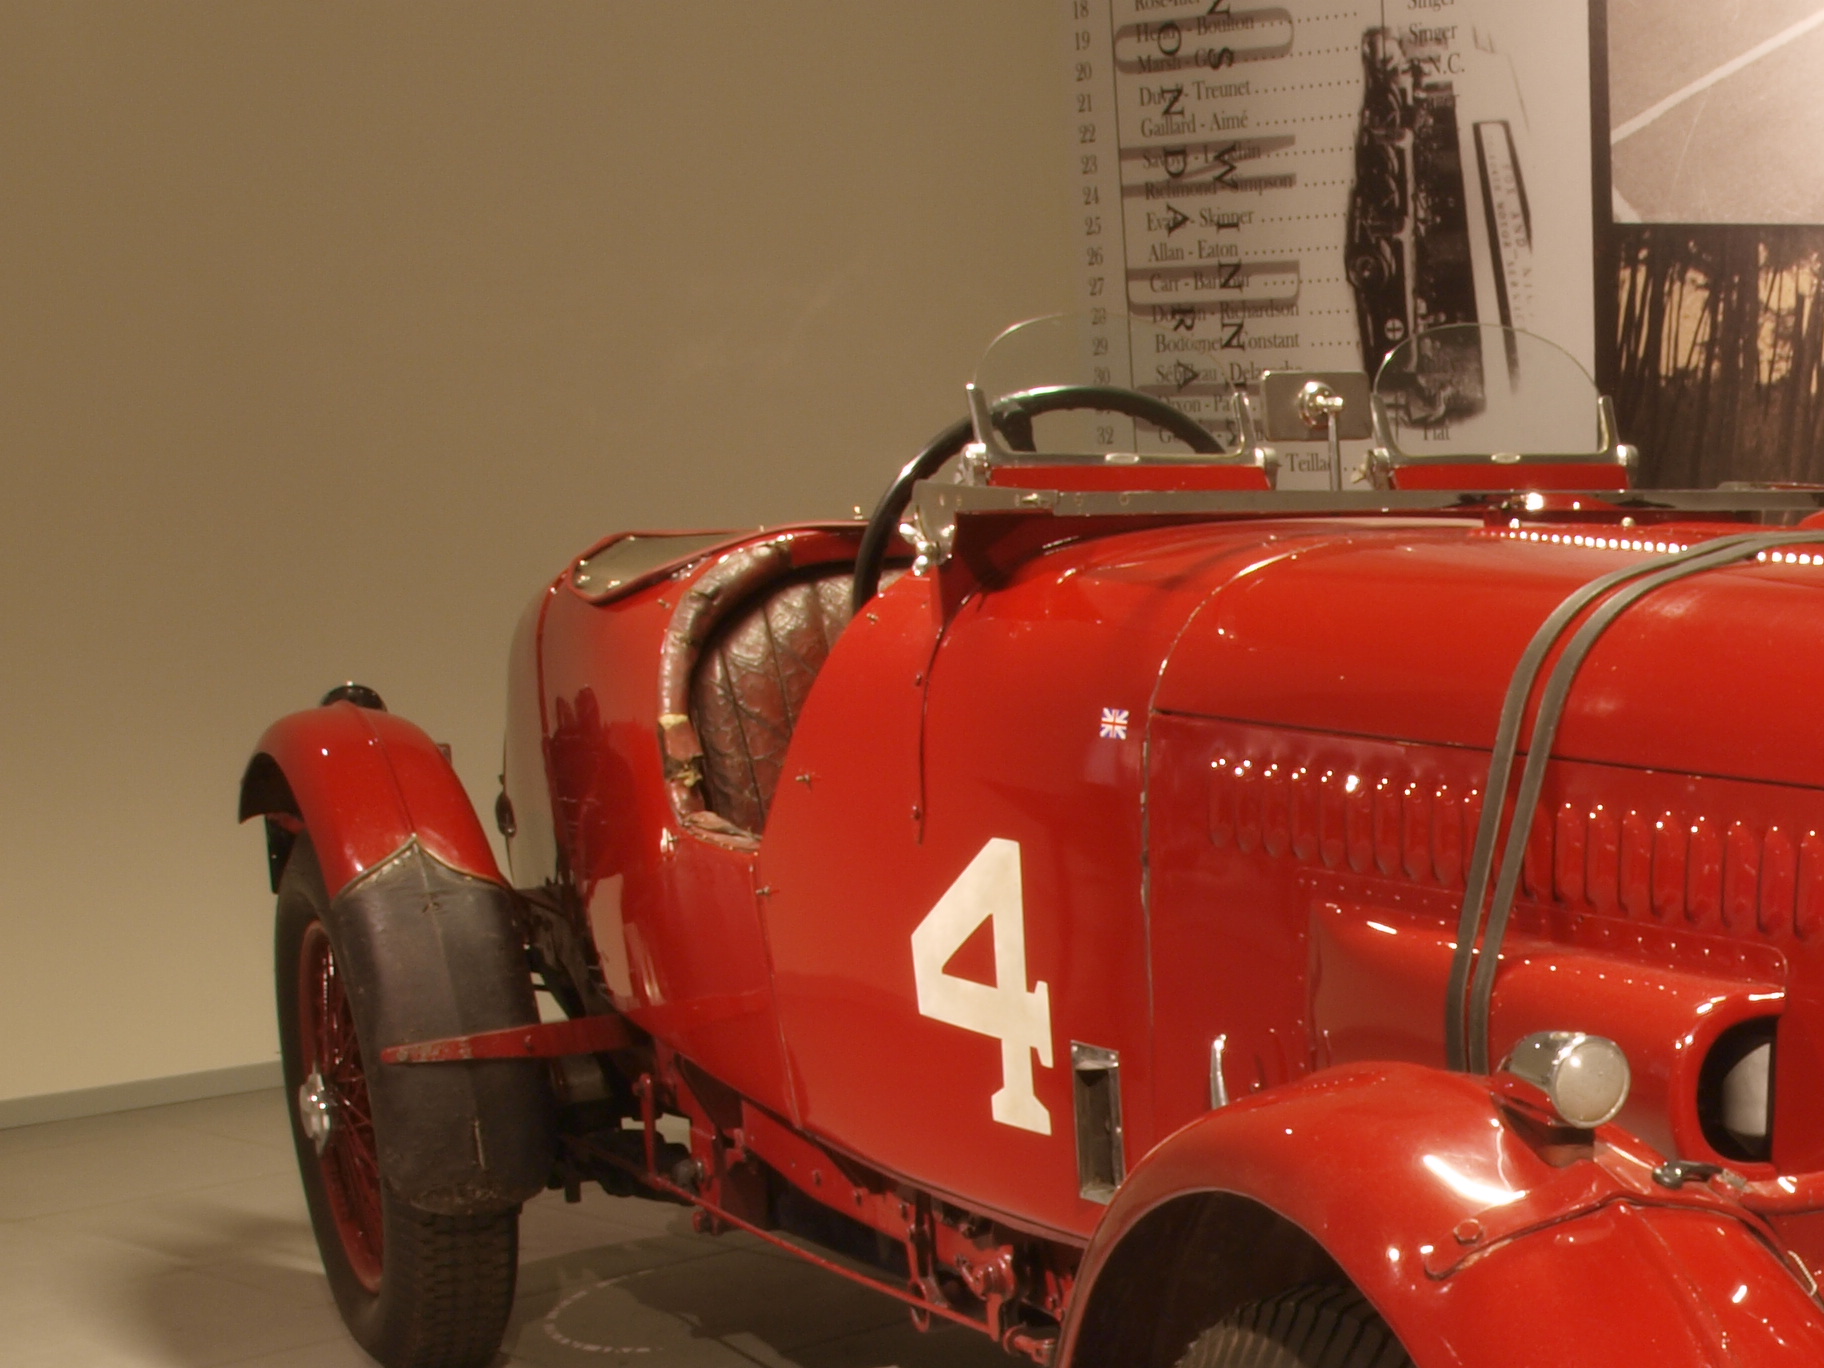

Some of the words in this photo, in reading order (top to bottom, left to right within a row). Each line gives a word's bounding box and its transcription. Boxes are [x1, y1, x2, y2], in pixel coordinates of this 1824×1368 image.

[1073, 0, 1090, 20] 18
[1075, 31, 1091, 51] 19
[1075, 62, 1092, 82] 20
[1077, 93, 1092, 113] 21
[1192, 80, 1250, 101] Treunet
[1079, 123, 1096, 144] 22
[1141, 113, 1196, 138] Gaillard
[1210, 110, 1248, 131] Aimé
[1081, 154, 1098, 175] 23
[1082, 186, 1099, 206] 24
[1085, 216, 1102, 236] 25
[1087, 246, 1104, 266] 26
[1148, 242, 1184, 262] Allan
[1198, 239, 1239, 259] Eaton
[1088, 277, 1105, 297] 27
[1220, 299, 1300, 320] Richardson
[1092, 337, 1109, 357] 29
[1096, 426, 1114, 445] 32
[911, 837, 1053, 1136] 4
